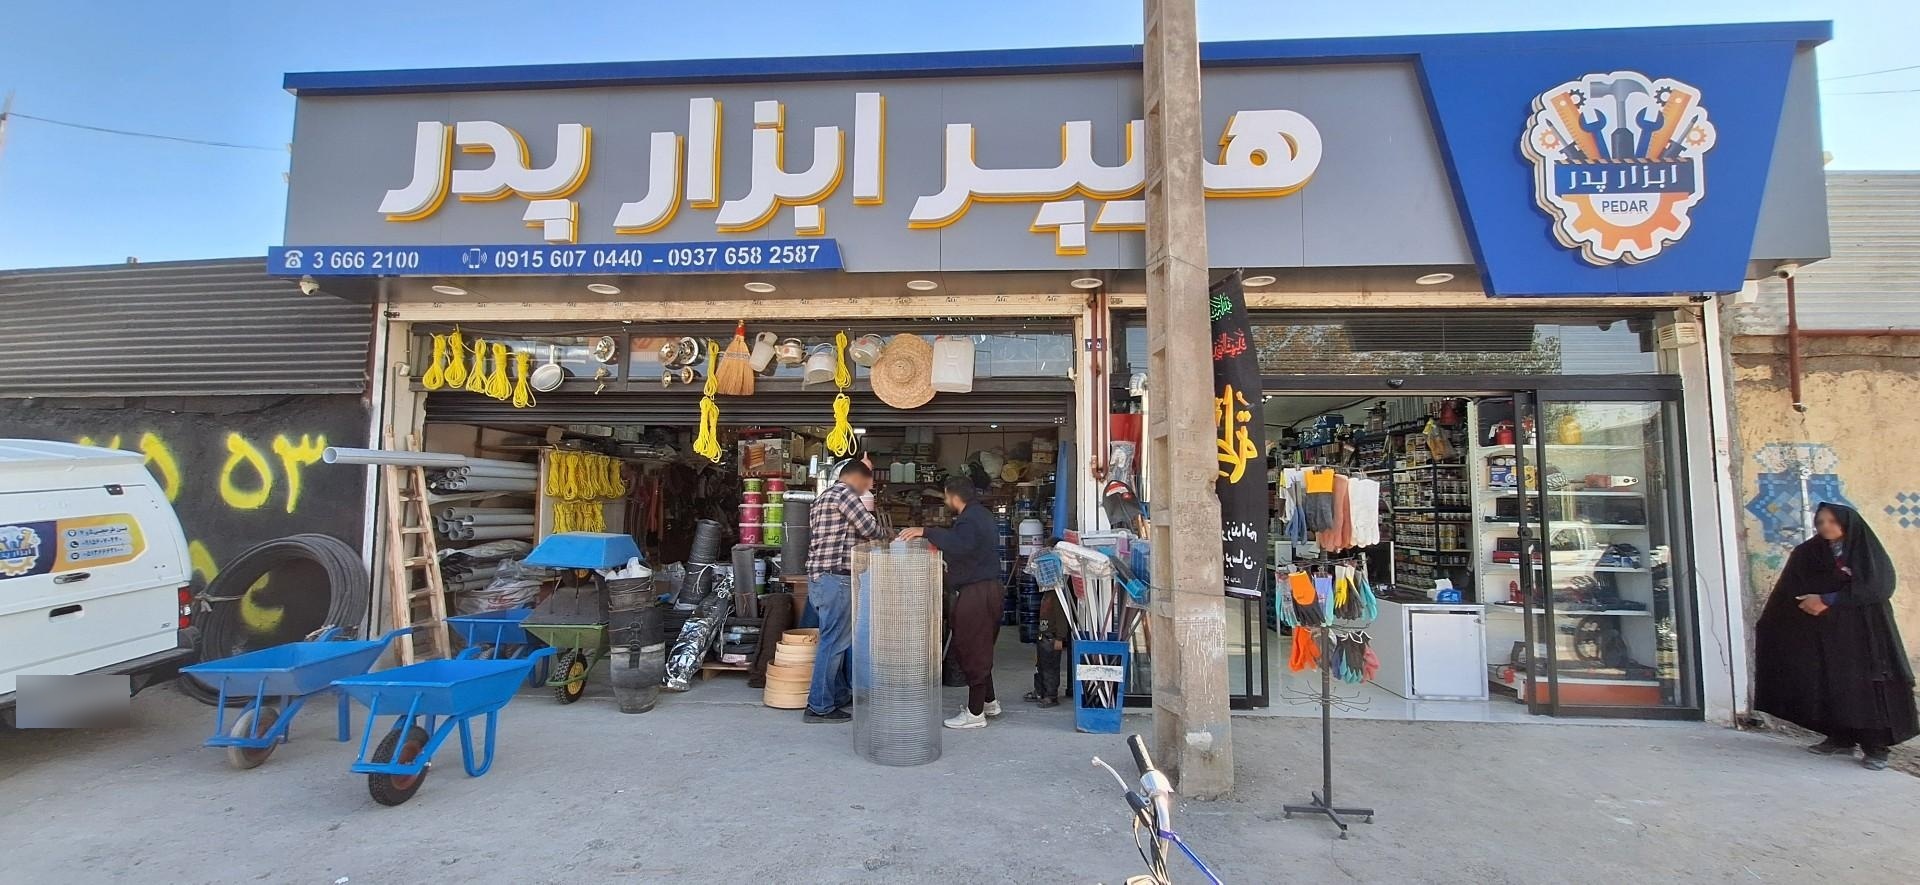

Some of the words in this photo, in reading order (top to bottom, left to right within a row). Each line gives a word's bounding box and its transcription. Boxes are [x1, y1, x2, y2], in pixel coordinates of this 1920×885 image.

[613, 92, 886, 236] ابزار
[1617, 164, 1678, 189] ابزار
[377, 120, 592, 244] پدر
[1568, 170, 1608, 193] پدر
[1601, 200, 1649, 213] PEDAR
[312, 252, 324, 270] 3
[330, 251, 366, 269] 666
[371, 251, 420, 269] 2100
[494, 250, 544, 269] 0915
[549, 249, 587, 268] 607
[593, 248, 643, 267] 0440
[667, 247, 719, 267] 0937
[723, 246, 763, 266] 658
[768, 244, 820, 264] 2587
